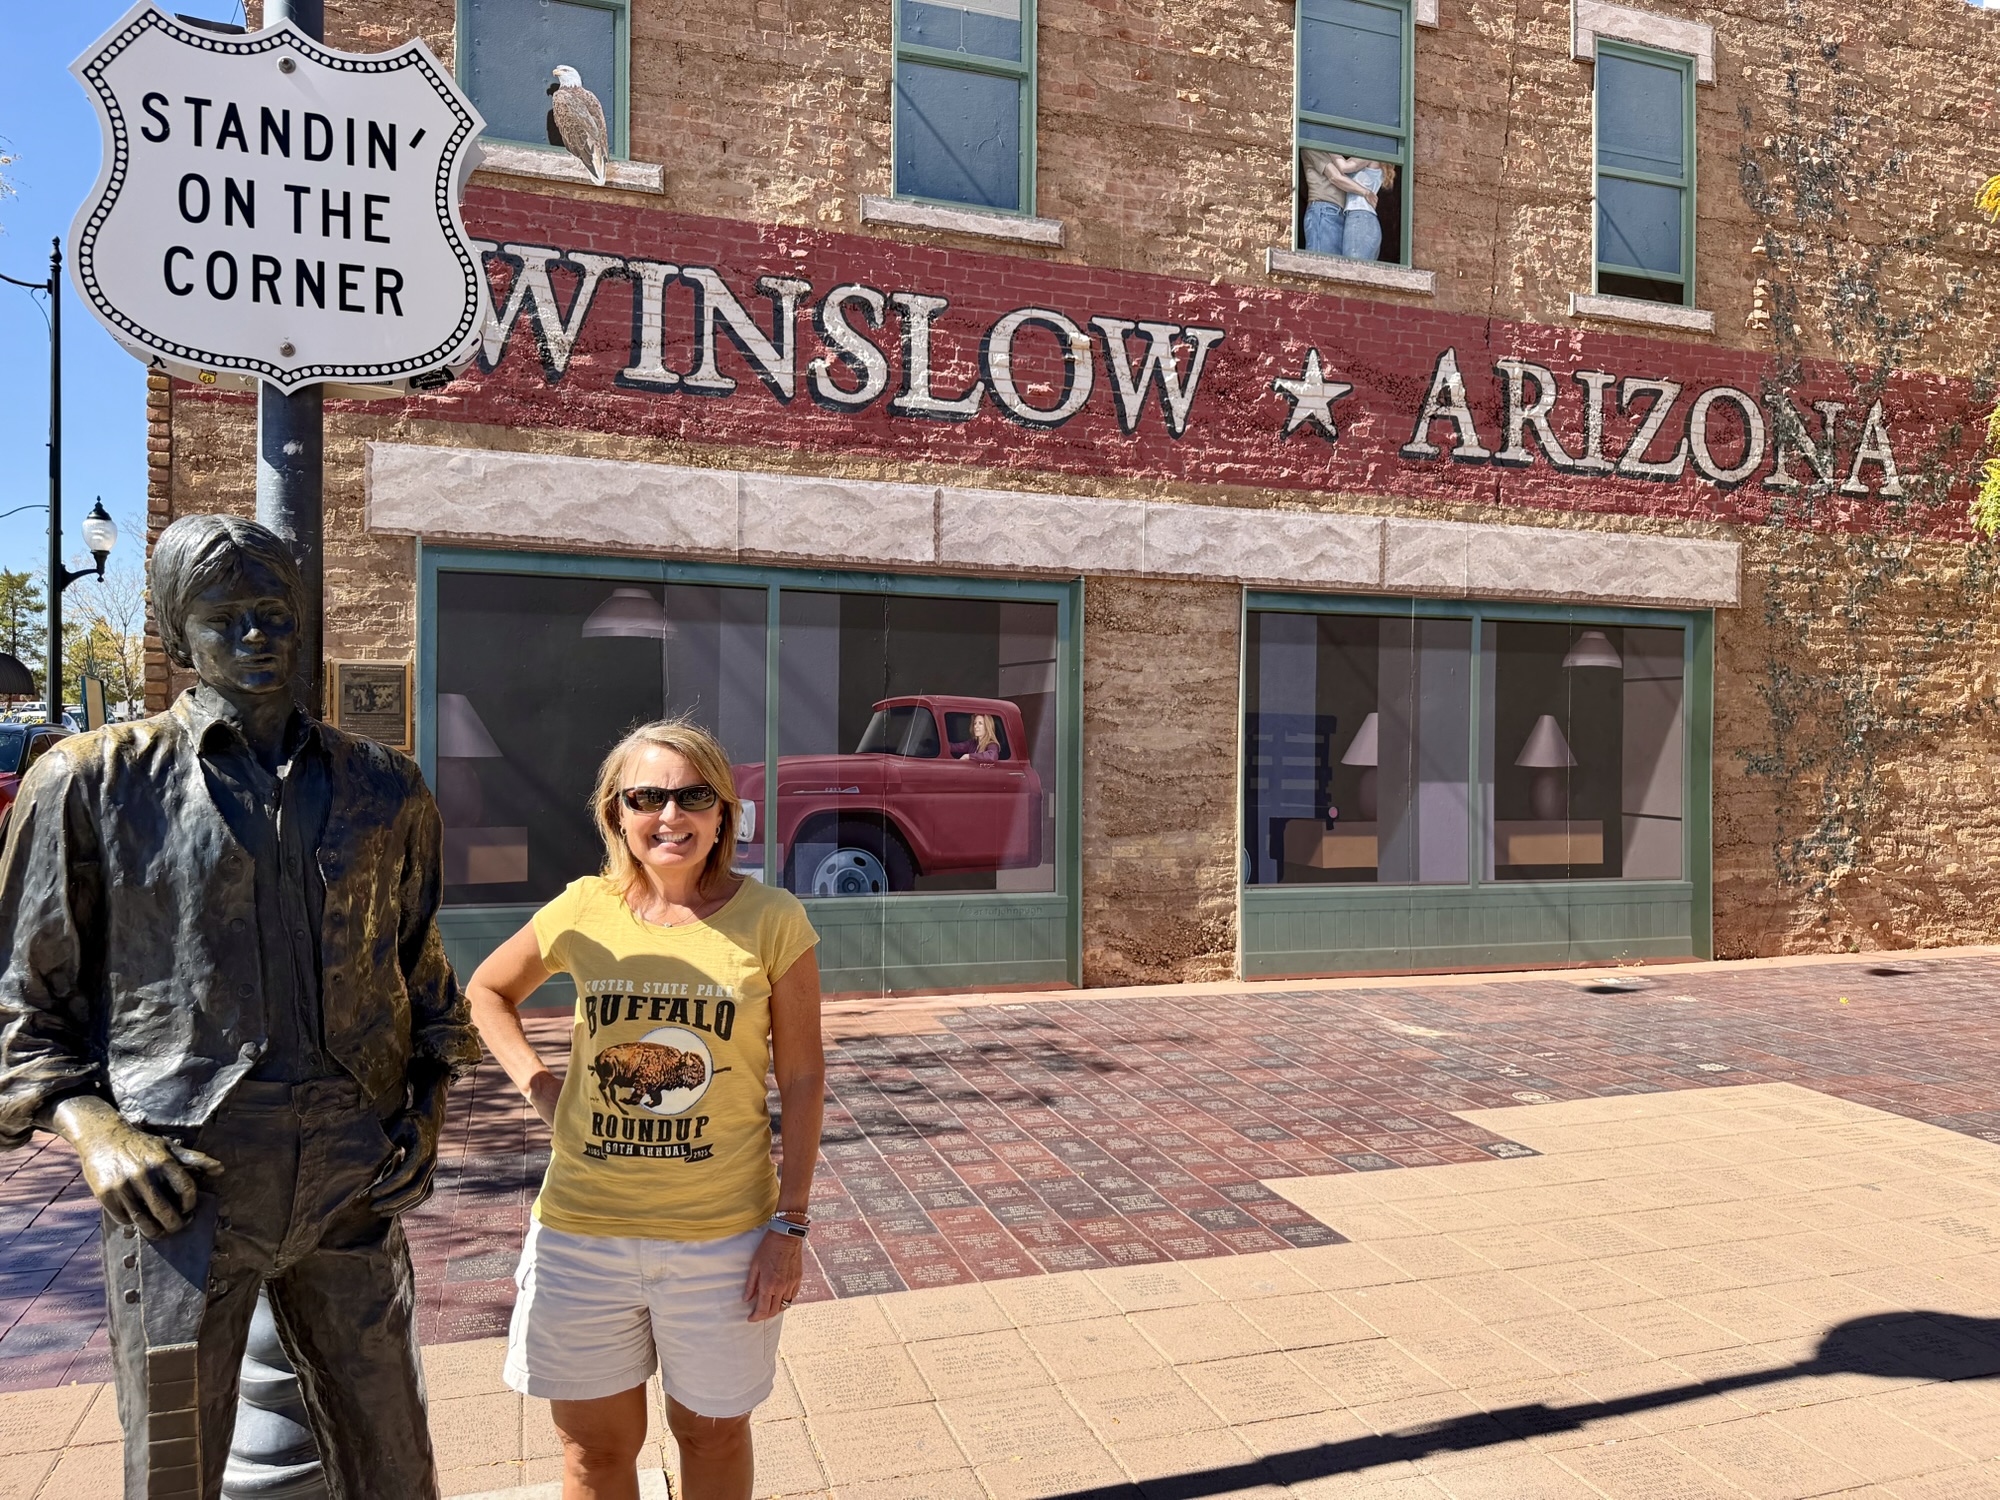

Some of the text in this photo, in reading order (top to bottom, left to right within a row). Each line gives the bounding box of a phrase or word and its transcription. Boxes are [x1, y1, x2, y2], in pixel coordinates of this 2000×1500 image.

[141, 92, 426, 171] STANDIN'
[179, 173, 391, 244] ON THE
[164, 245, 404, 317] CORNER
[472, 239, 1906, 498] WINSLOW ARIZONA
[585, 979, 735, 998] CUSTER STATE PARK
[585, 994, 736, 1041] BUFFALO
[592, 1112, 710, 1142] ROUNDUP
[605, 1142, 688, 1157] 60TH ANNUAL
